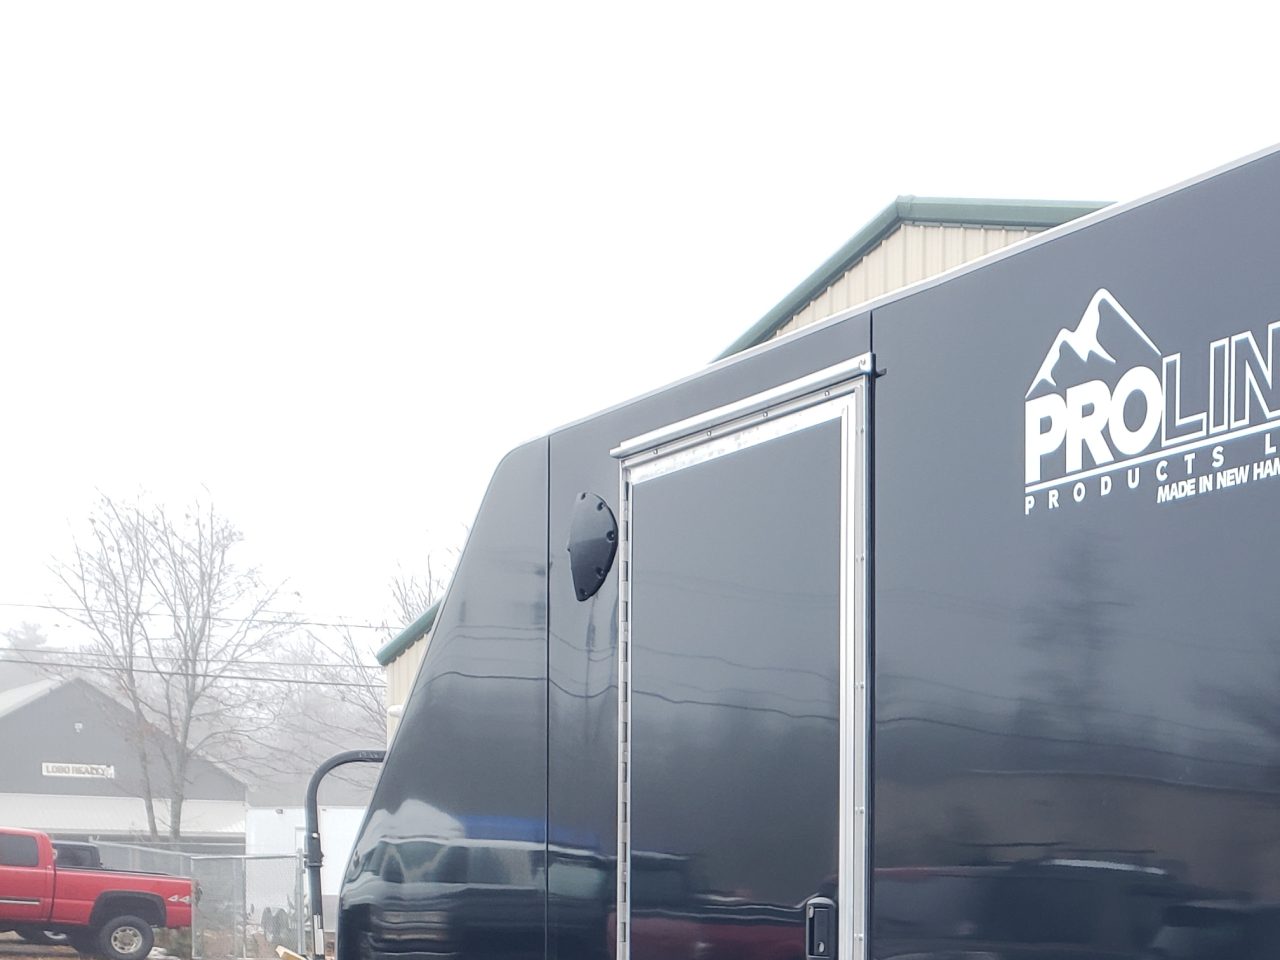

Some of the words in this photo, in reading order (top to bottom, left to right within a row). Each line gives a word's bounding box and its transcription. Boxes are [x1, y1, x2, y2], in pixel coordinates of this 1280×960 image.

[1025, 446, 1224, 515] PRODUCTS
[1157, 477, 1196, 503] MADE
[1199, 474, 1213, 493] IN
[1217, 466, 1249, 489] NEW
